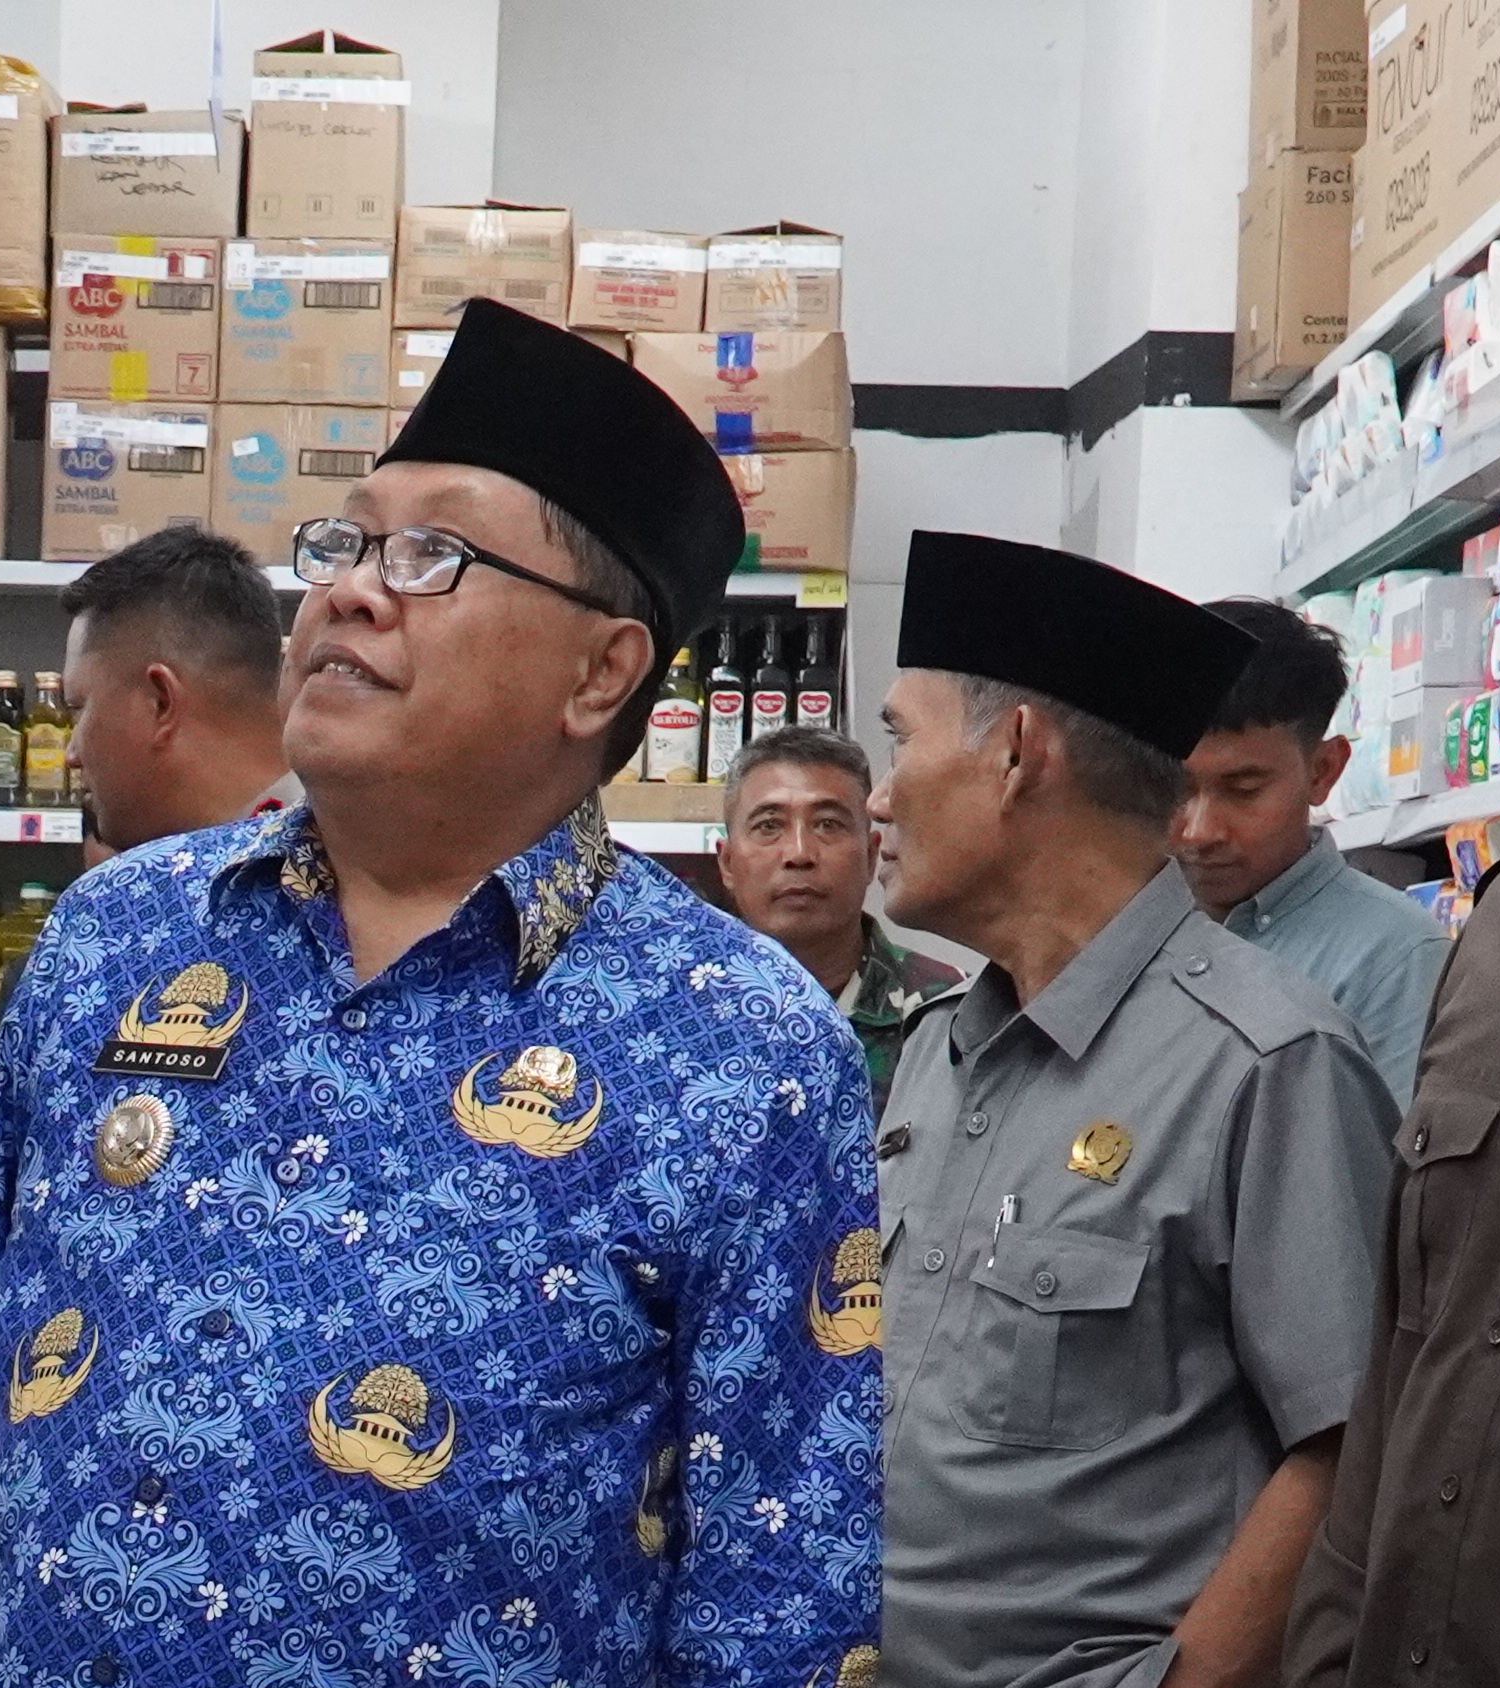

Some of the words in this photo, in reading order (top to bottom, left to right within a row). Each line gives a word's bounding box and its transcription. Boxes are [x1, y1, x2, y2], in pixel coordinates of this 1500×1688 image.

[73, 289, 122, 308] ABC
[64, 323, 128, 340] SAMBAL
[188, 366, 199, 382] 7
[64, 456, 112, 471] ABC
[54, 486, 119, 502] SAMBAL
[113, 1049, 207, 1068] SANTOSO
